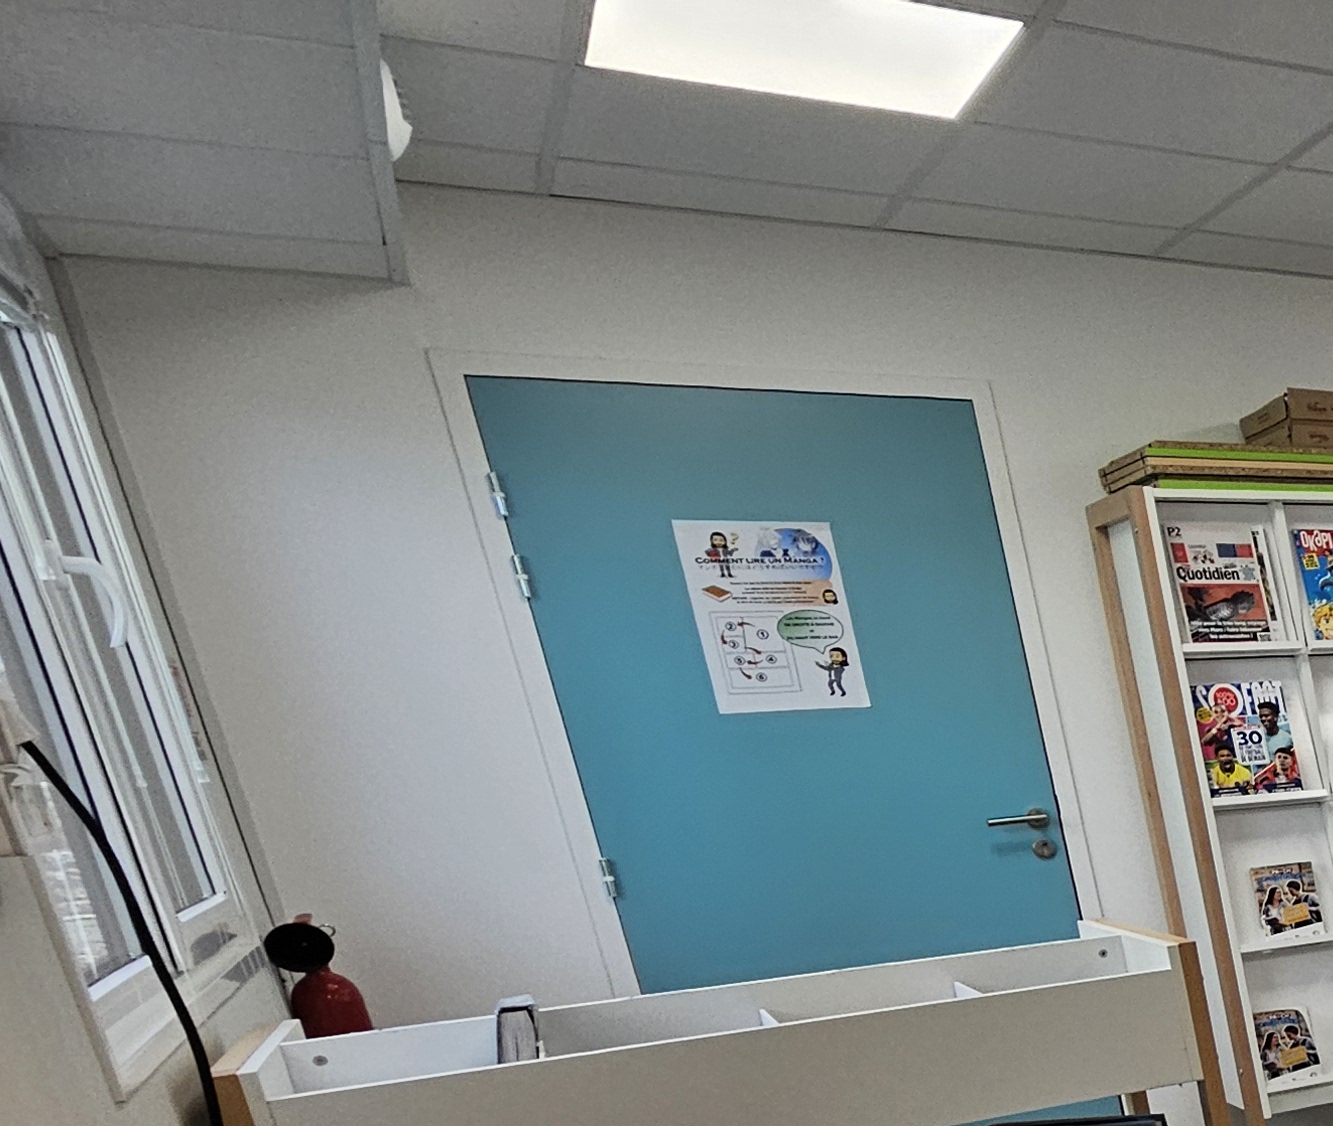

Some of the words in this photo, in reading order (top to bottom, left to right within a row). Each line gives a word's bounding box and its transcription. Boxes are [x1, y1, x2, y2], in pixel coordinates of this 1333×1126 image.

[1166, 526, 1181, 536] P2
[1176, 566, 1240, 582] Quotidien
[1236, 730, 1262, 745] 30
